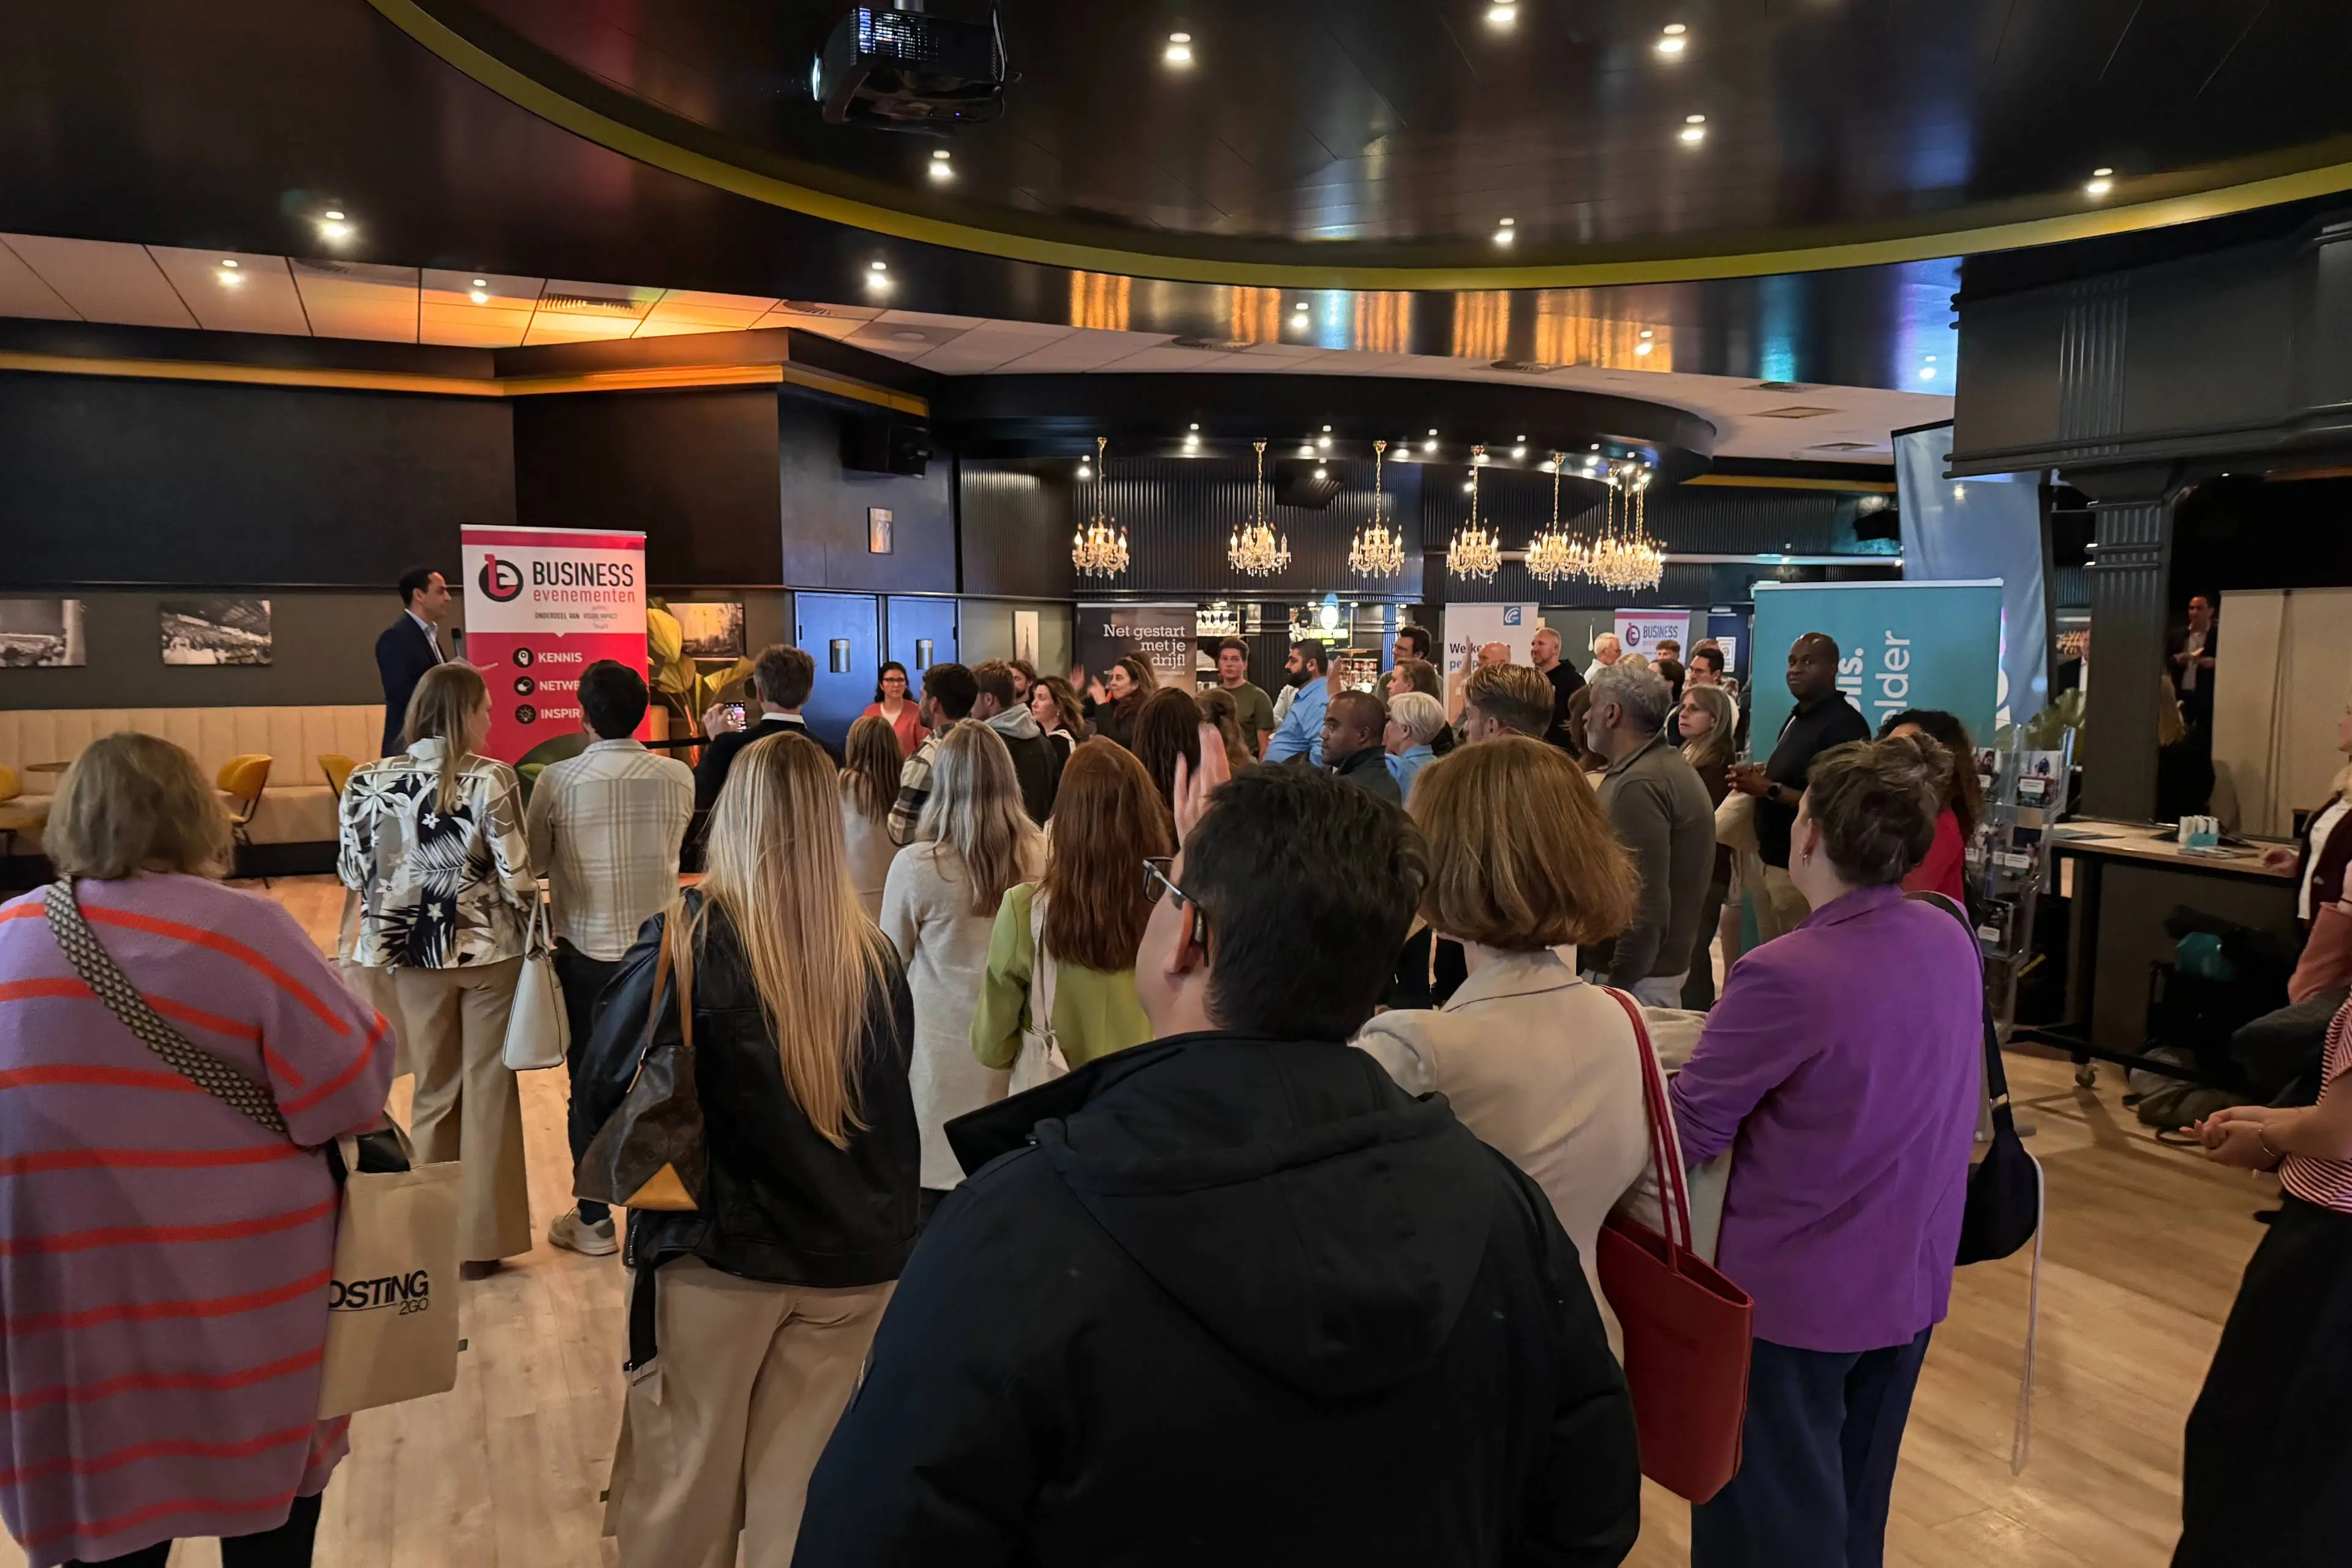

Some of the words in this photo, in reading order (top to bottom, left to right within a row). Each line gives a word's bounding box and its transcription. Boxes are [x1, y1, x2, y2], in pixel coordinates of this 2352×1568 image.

[532, 561, 634, 587] BUSINESS
[533, 589, 635, 603] evenementen
[1103, 624, 1130, 637] Net
[1134, 625, 1185, 640] gestart
[1643, 625, 1678, 638] BUSINESS
[1140, 640, 1169, 652] met
[1172, 639, 1186, 654] je
[538, 652, 582, 663] KENNIS
[1151, 654, 1185, 669] drijf!
[539, 680, 581, 691] NETWE
[541, 708, 580, 719] INSPIR
[329, 1270, 428, 1308] OSTING
[398, 1297, 428, 1315] 2GO
